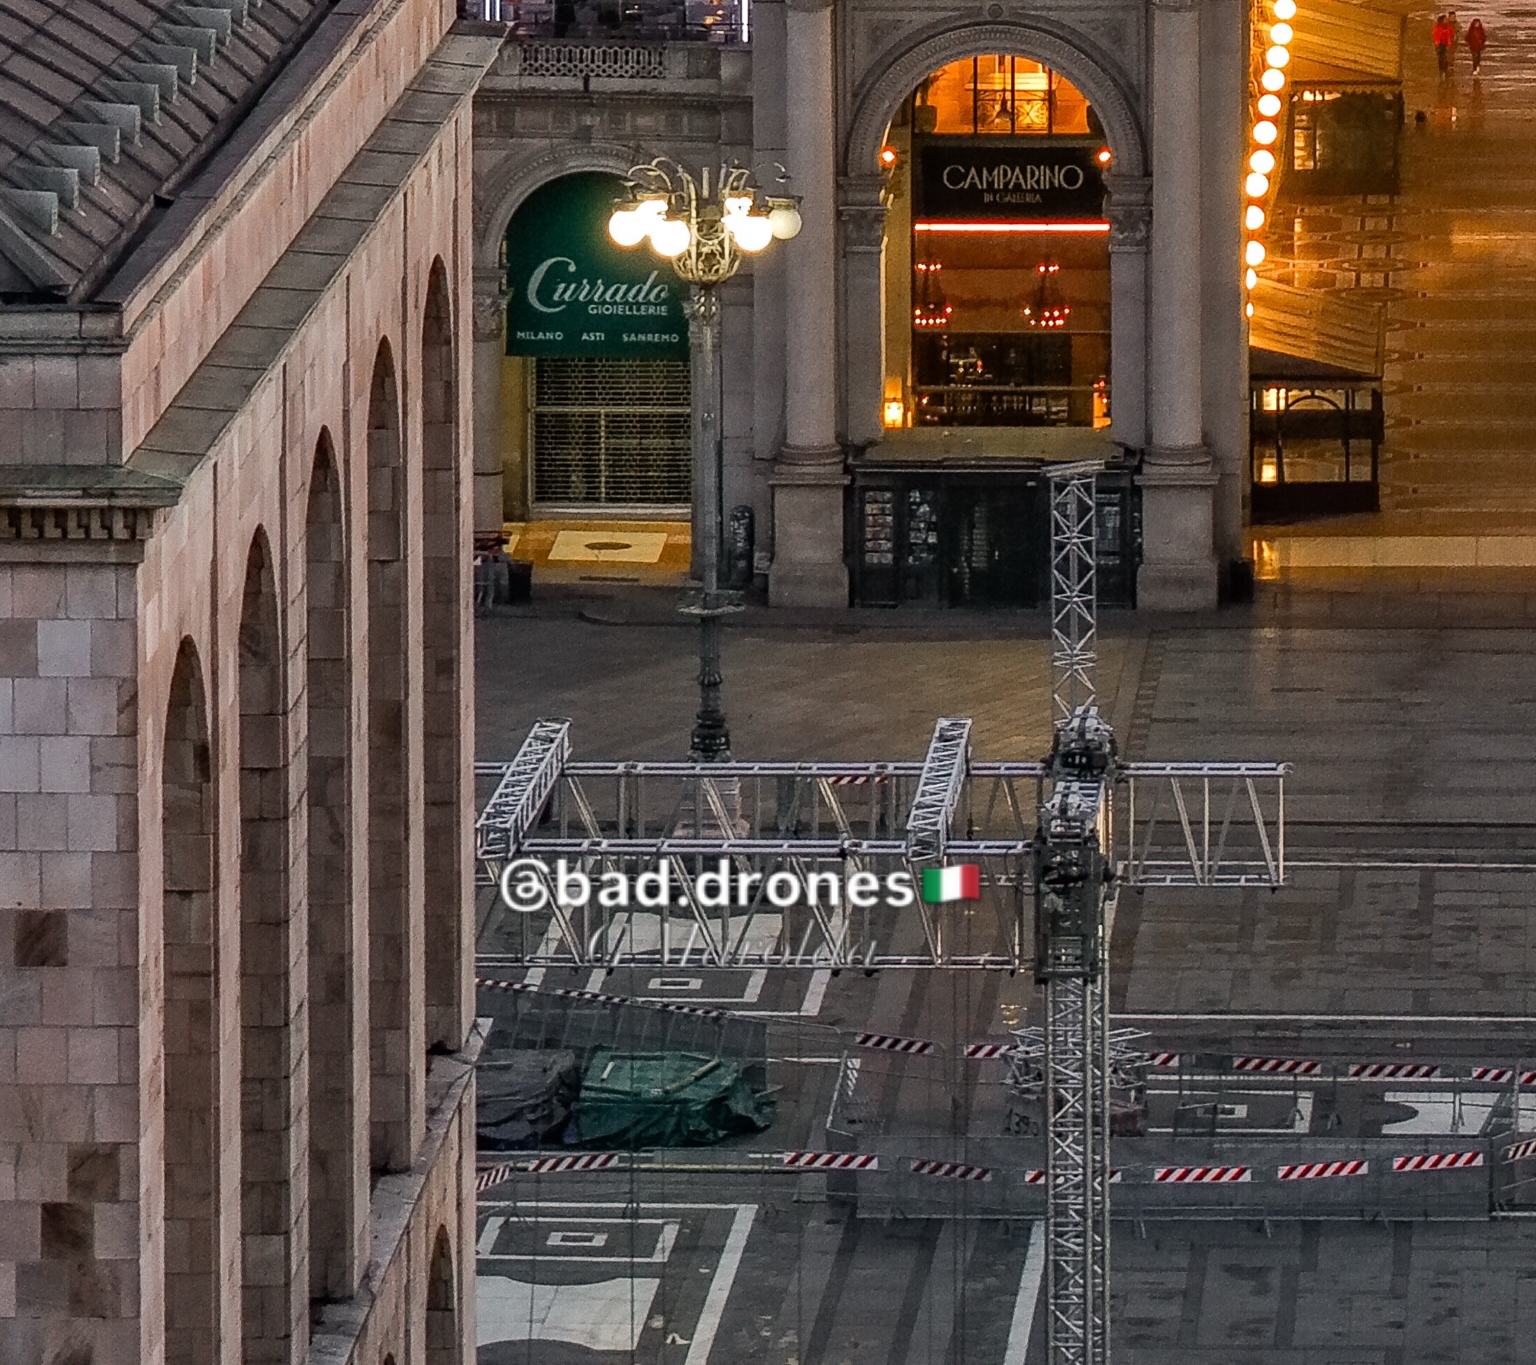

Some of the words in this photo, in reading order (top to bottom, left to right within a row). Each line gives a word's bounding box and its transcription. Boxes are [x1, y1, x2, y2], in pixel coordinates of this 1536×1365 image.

[943, 164, 1084, 190] CAMPARINO
[527, 256, 670, 313] Currado
[588, 304, 669, 316] GIOIELLERIE
[516, 331, 564, 341] MILANO
[581, 332, 605, 341] ASTI
[622, 333, 680, 343] SANREMO
